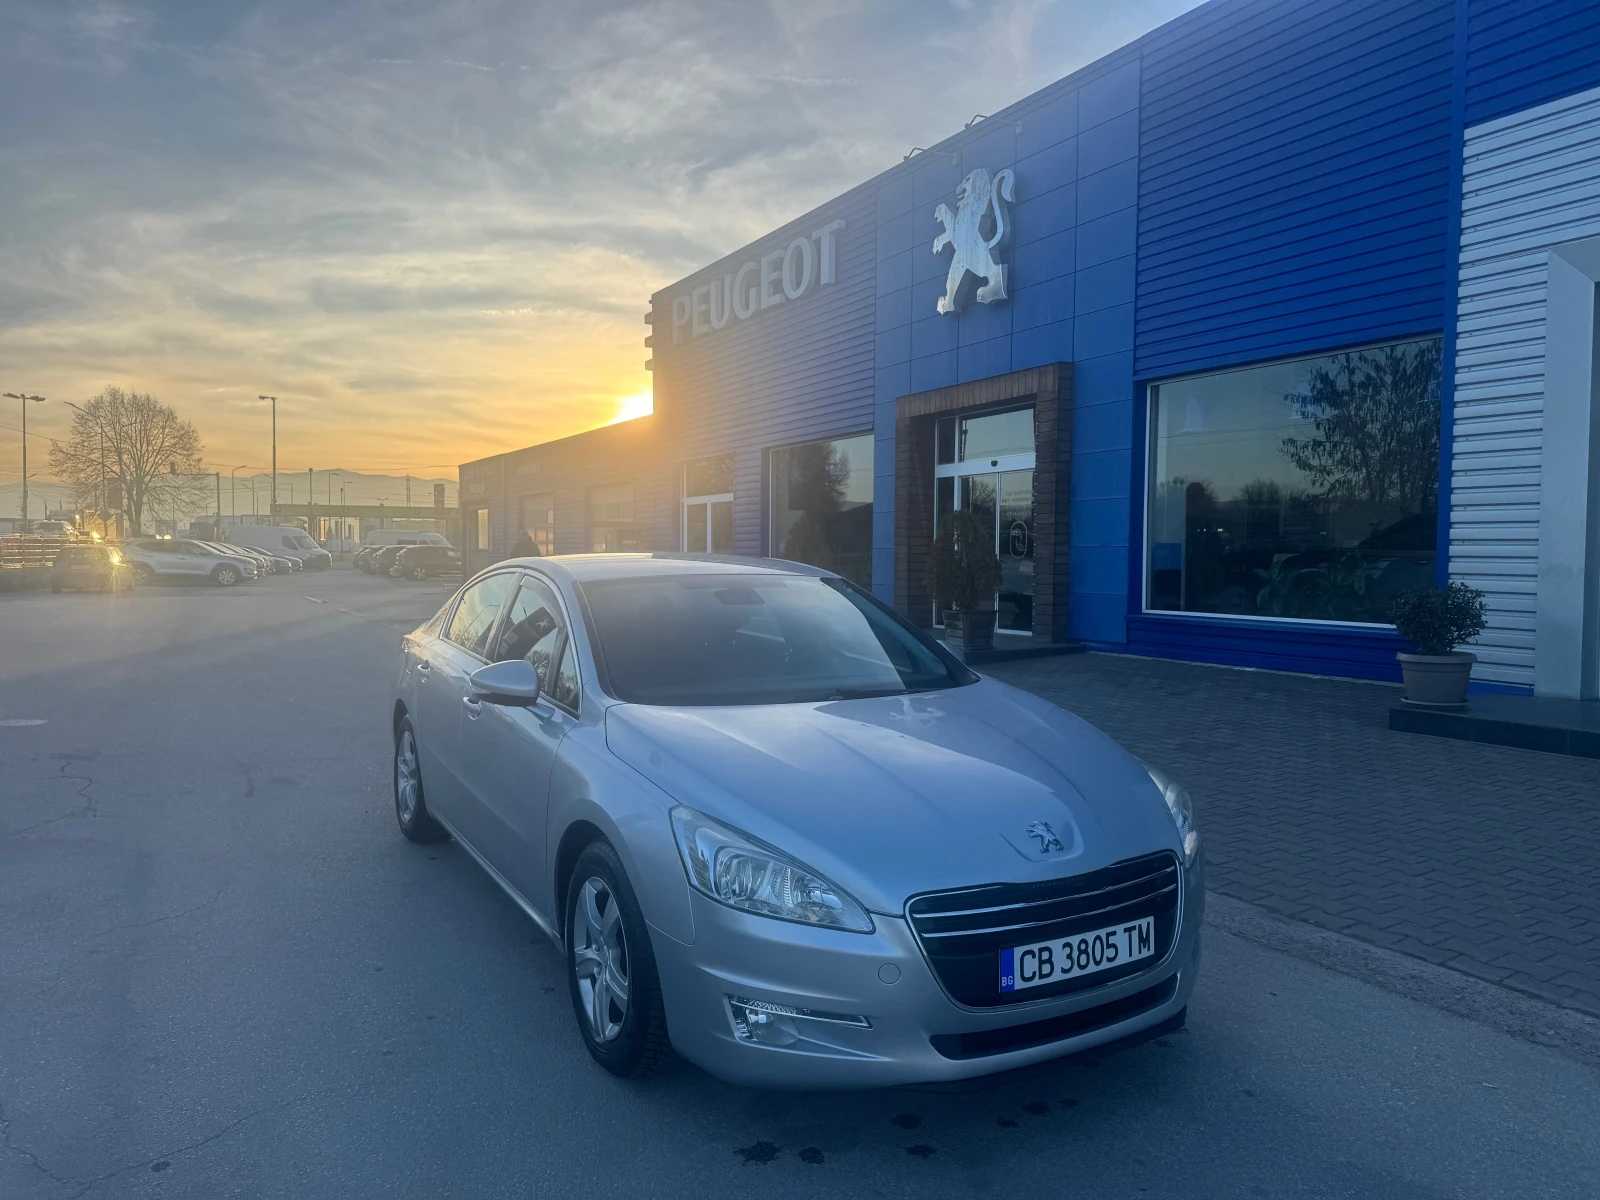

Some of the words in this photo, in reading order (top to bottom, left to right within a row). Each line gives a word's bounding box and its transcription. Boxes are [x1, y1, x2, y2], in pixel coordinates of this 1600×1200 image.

[672, 218, 846, 346] PEUGEOT
[1001, 975, 1014, 987] BG
[1019, 945, 1055, 983] CB
[1060, 930, 1119, 974] 3805
[1123, 921, 1151, 957] TM
